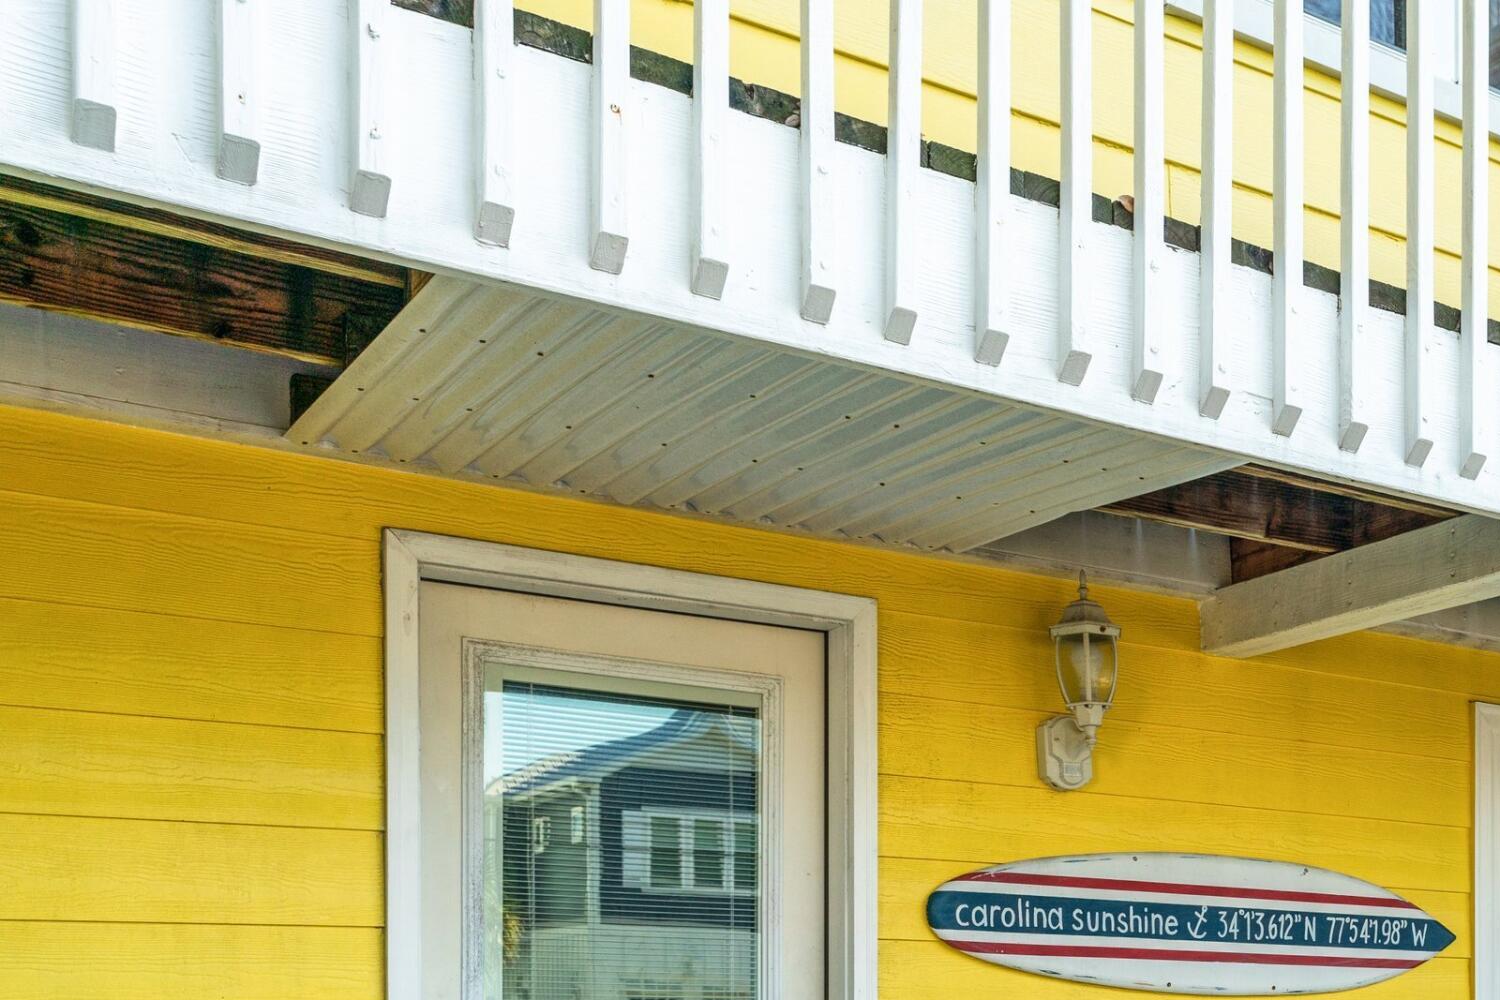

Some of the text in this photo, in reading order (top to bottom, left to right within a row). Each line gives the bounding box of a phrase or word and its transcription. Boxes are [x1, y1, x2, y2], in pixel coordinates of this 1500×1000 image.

[955, 898, 1064, 931] carolina
[1071, 905, 1179, 937] sunshine
[1304, 916, 1317, 942] N
[1411, 922, 1428, 948] W
